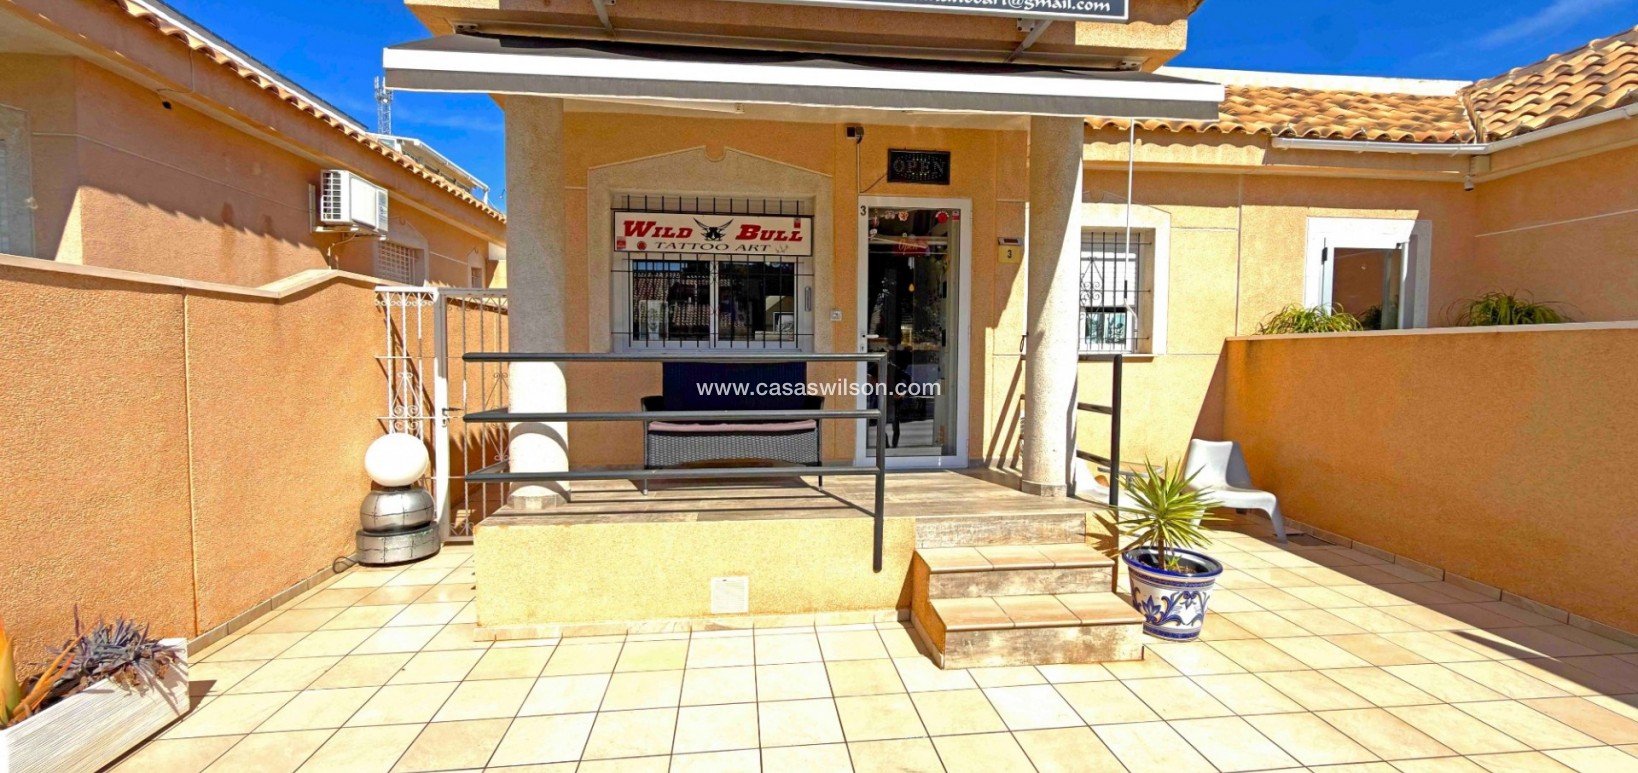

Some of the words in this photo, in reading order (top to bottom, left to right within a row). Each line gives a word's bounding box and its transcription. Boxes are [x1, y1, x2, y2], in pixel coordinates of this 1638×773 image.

[893, 159, 945, 175] OPEN
[860, 205, 867, 216] 3
[623, 220, 693, 238] WILD
[735, 224, 804, 242] BULL
[655, 241, 729, 251] TATTOO
[735, 243, 771, 252] ART
[1007, 249, 1012, 259] 3
